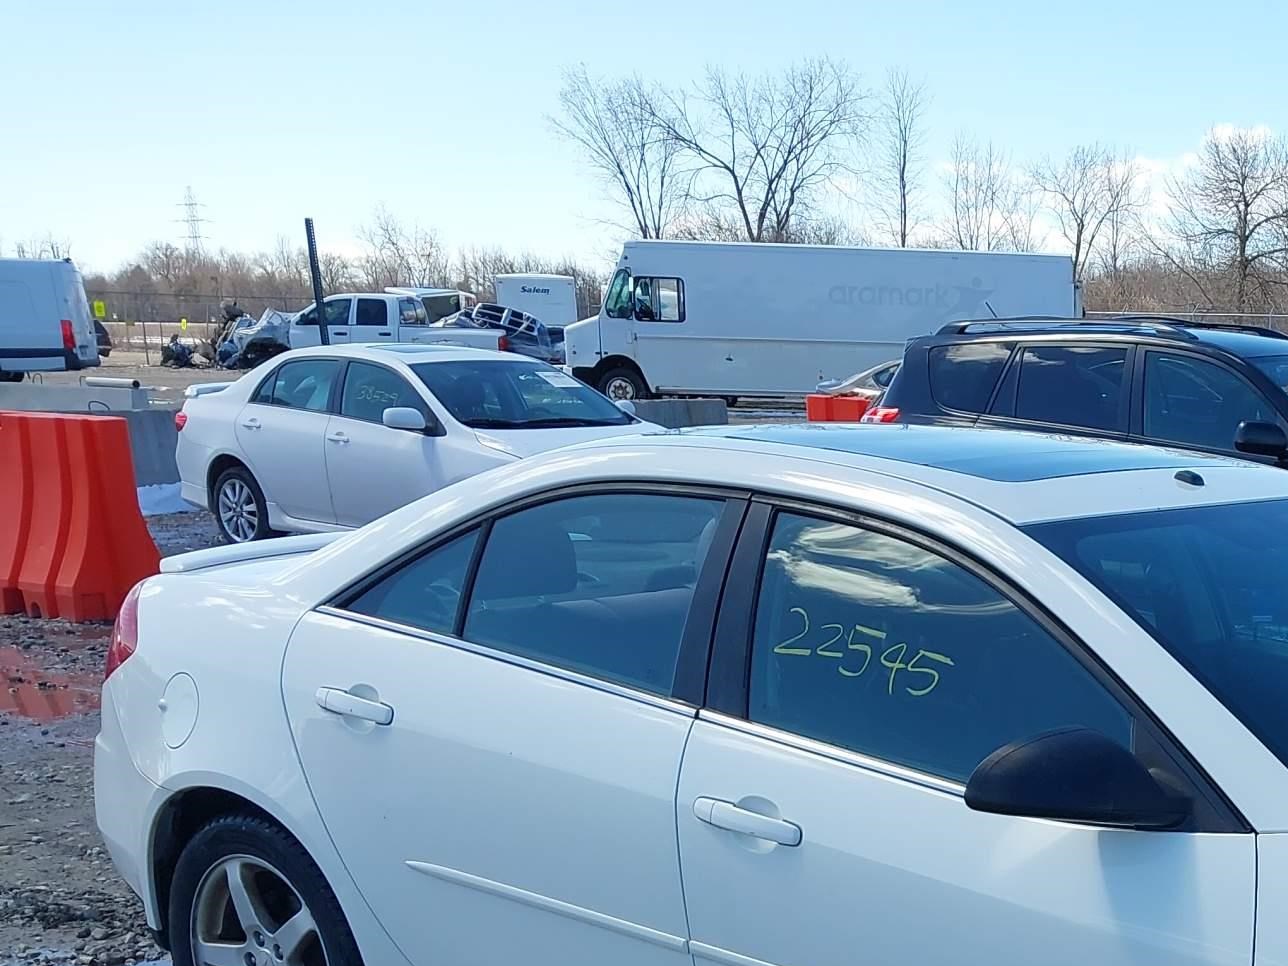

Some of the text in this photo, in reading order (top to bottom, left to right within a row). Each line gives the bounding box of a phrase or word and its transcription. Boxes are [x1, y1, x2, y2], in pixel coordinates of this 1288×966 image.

[520, 286, 551, 295] Salem
[828, 283, 950, 306] aramark
[773, 607, 956, 696] 22545
